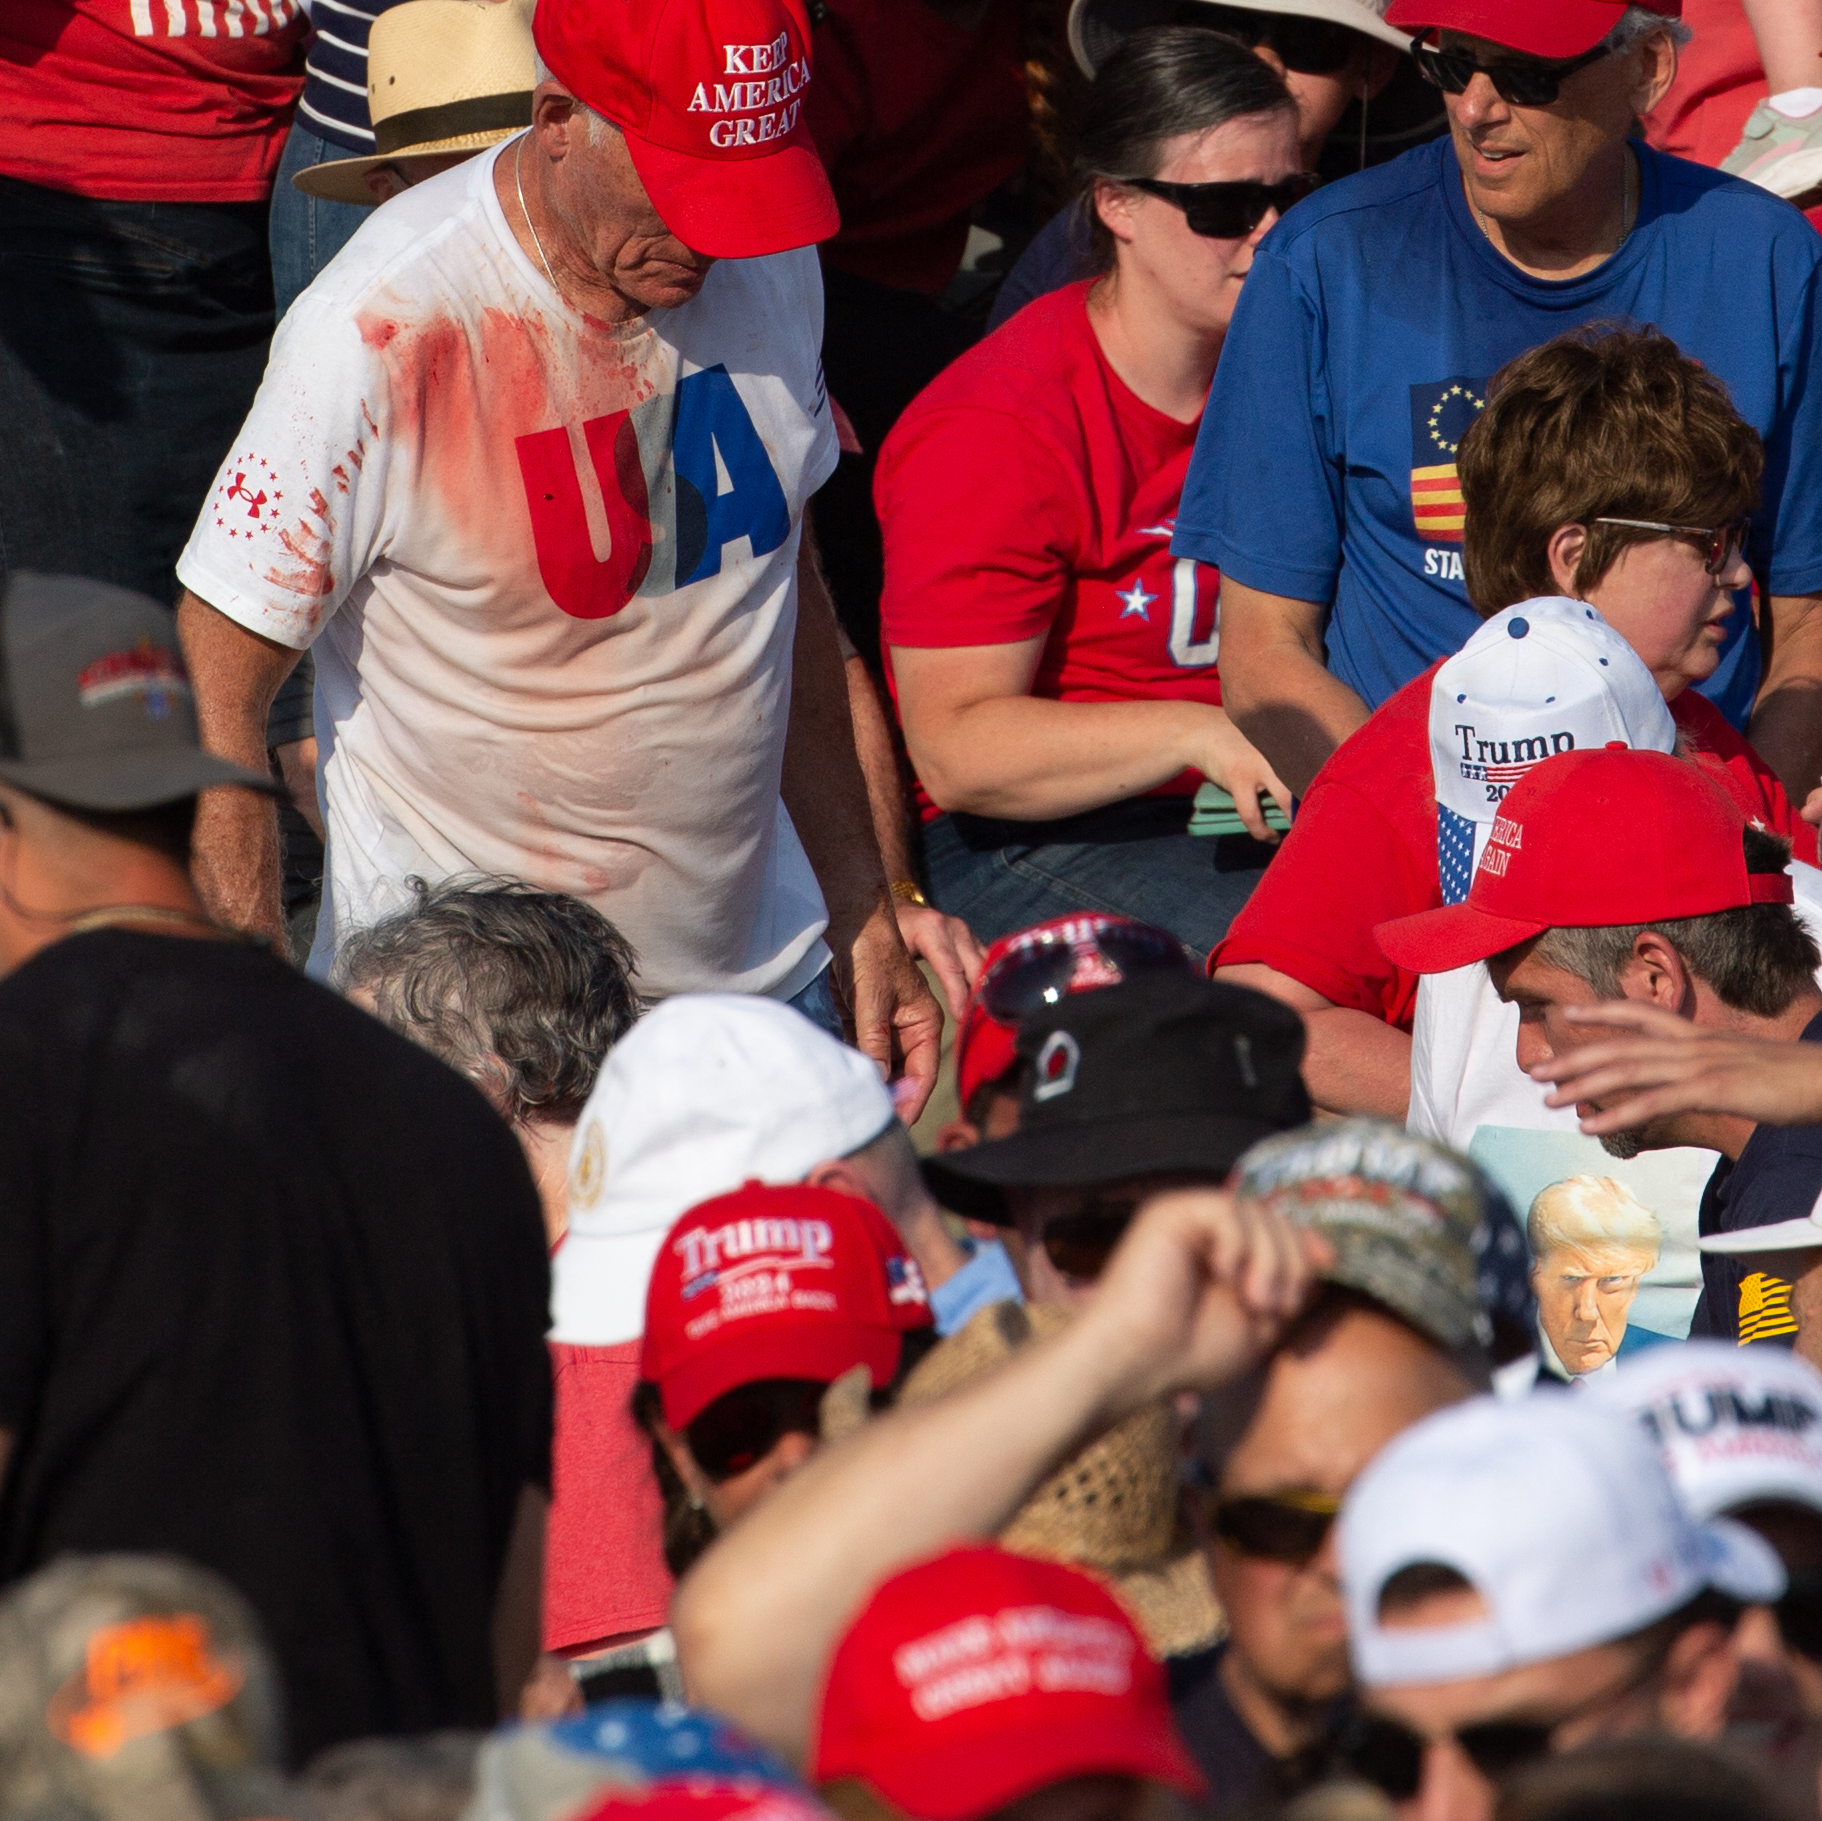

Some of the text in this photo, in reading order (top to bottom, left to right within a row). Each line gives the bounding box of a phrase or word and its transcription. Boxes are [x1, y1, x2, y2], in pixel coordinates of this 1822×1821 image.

[723, 31, 788, 74] KEEP
[687, 56, 811, 112] AMERICA
[709, 98, 800, 148] GREAT
[514, 362, 791, 620] USA
[1455, 724, 1575, 765] Trump
[672, 1215, 833, 1276] Trump
